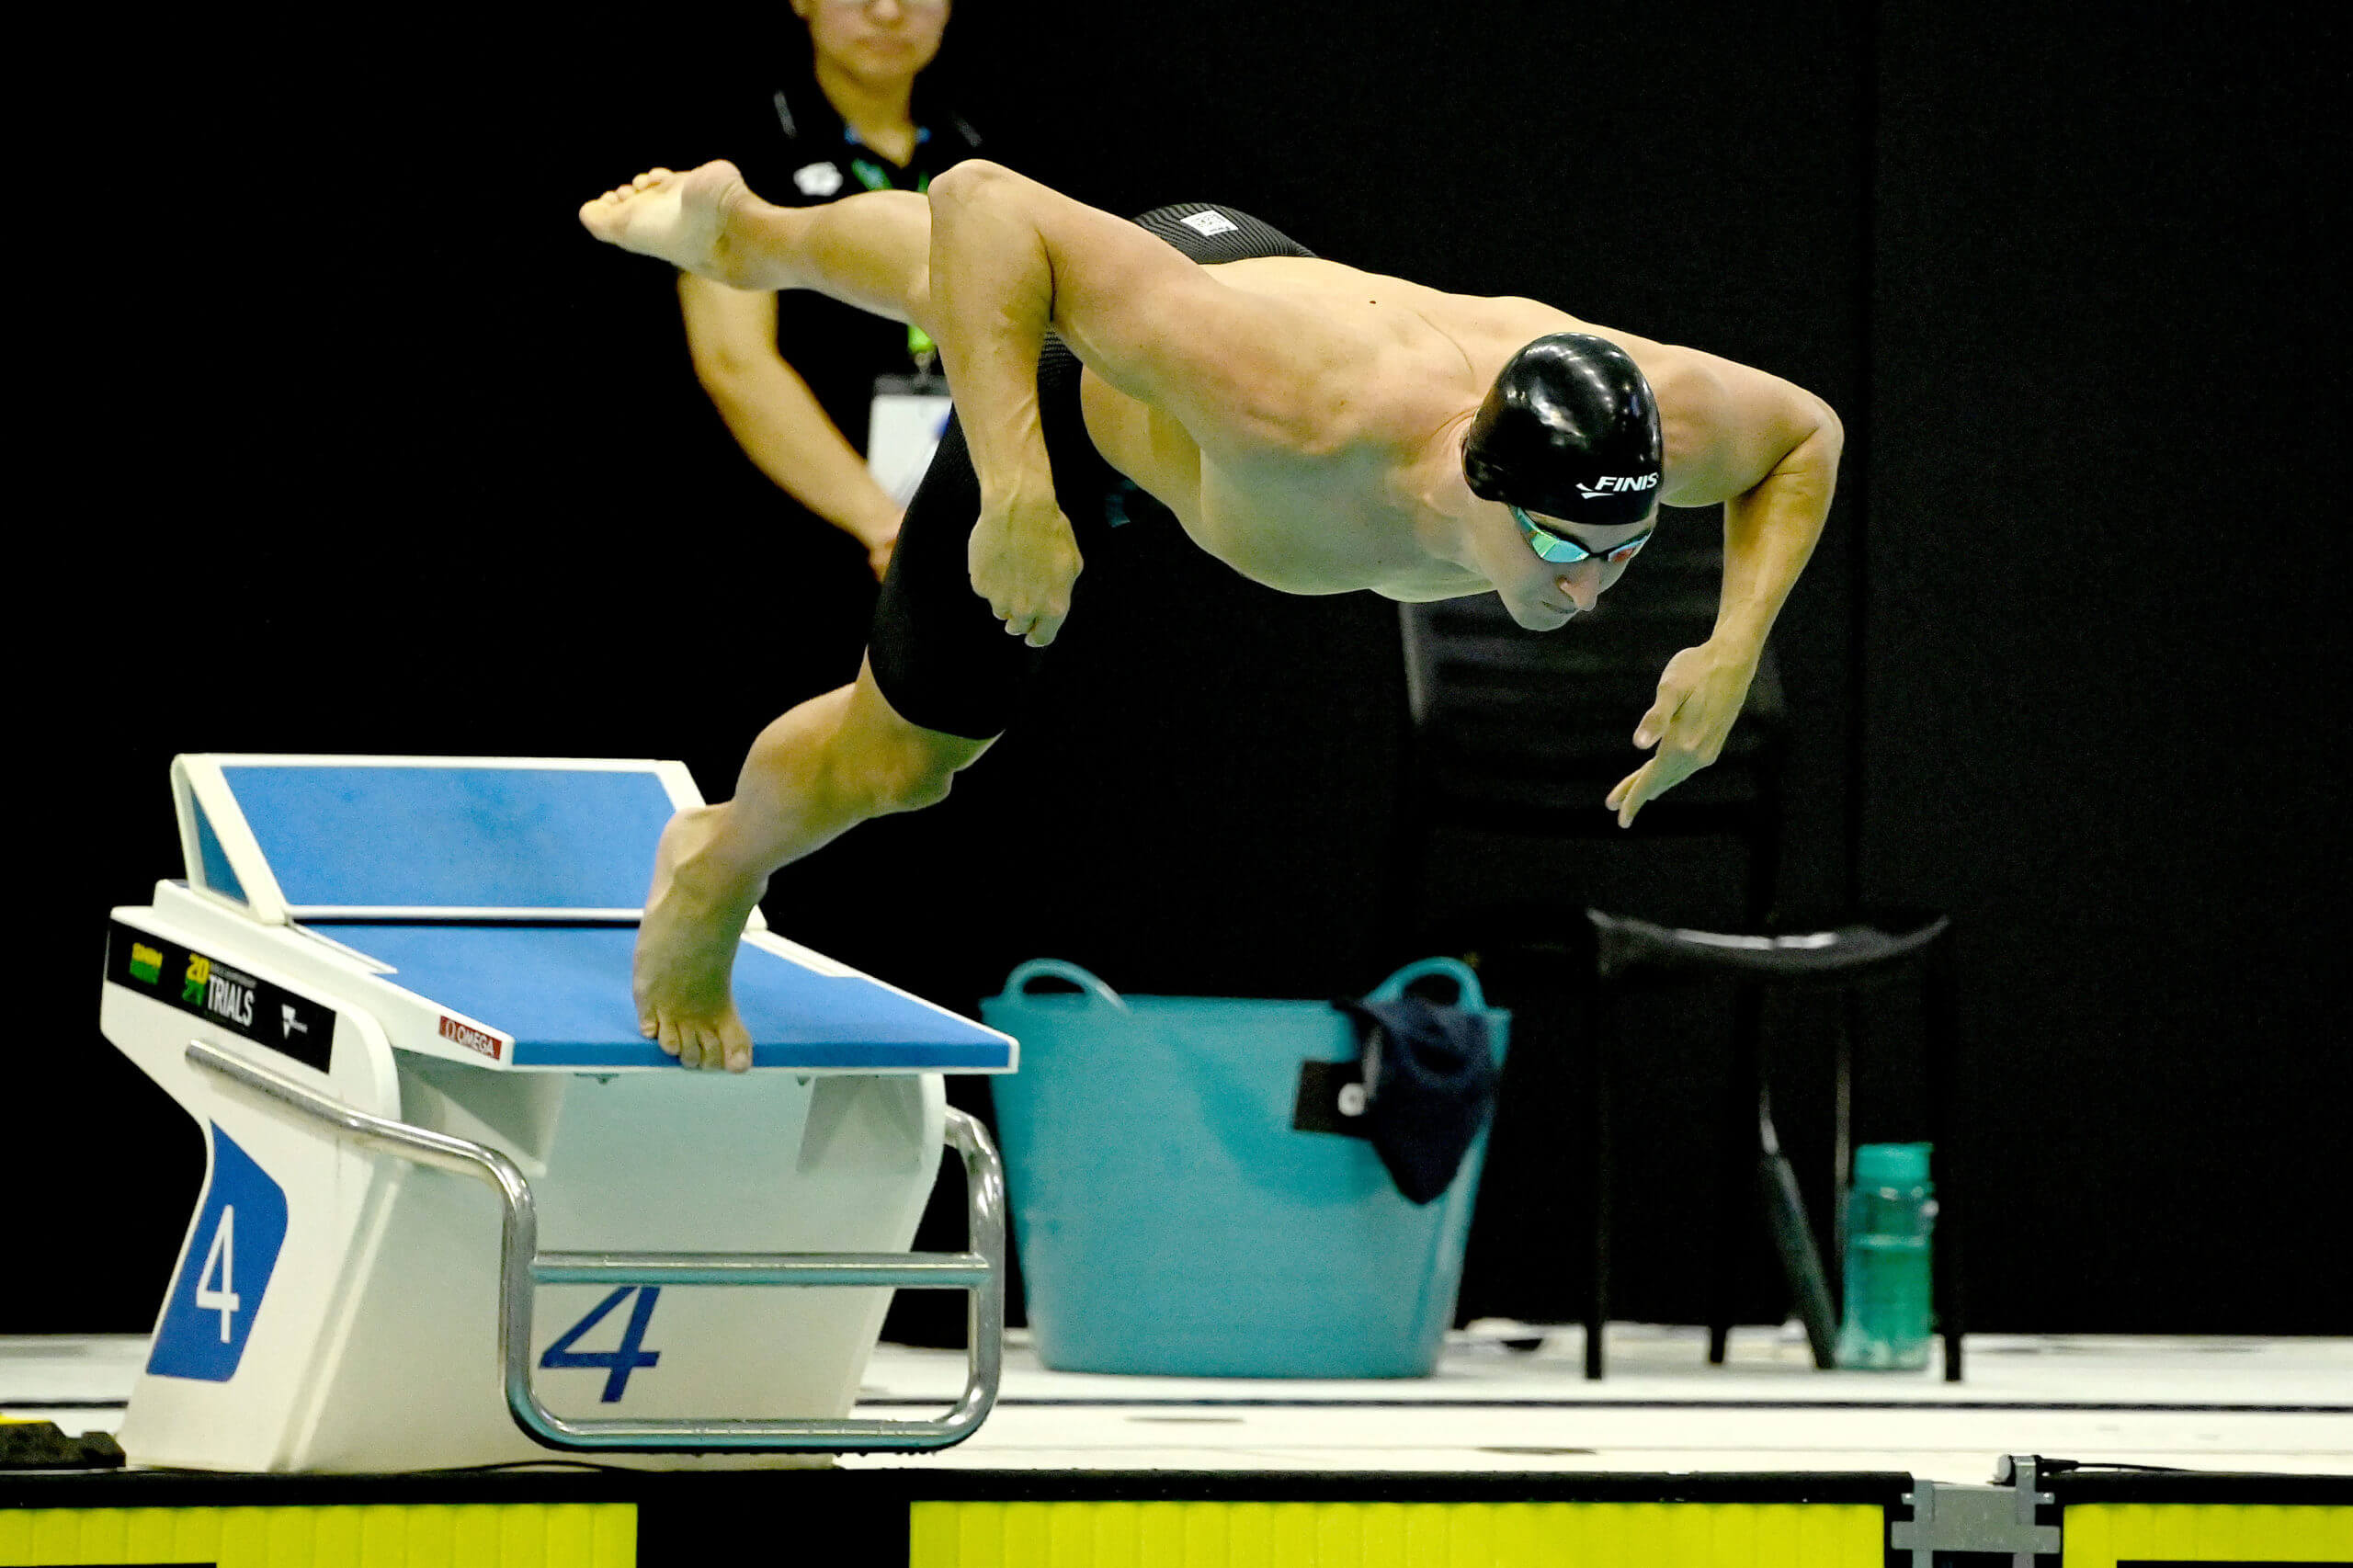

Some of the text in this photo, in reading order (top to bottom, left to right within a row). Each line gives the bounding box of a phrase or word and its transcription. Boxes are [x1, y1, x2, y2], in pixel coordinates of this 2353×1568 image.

[1595, 472, 1659, 492] FINIS
[208, 974, 255, 1027] TRIALS
[457, 1026, 494, 1056] OMEGA
[196, 1204, 239, 1344] 4
[539, 1286, 660, 1403] 4
